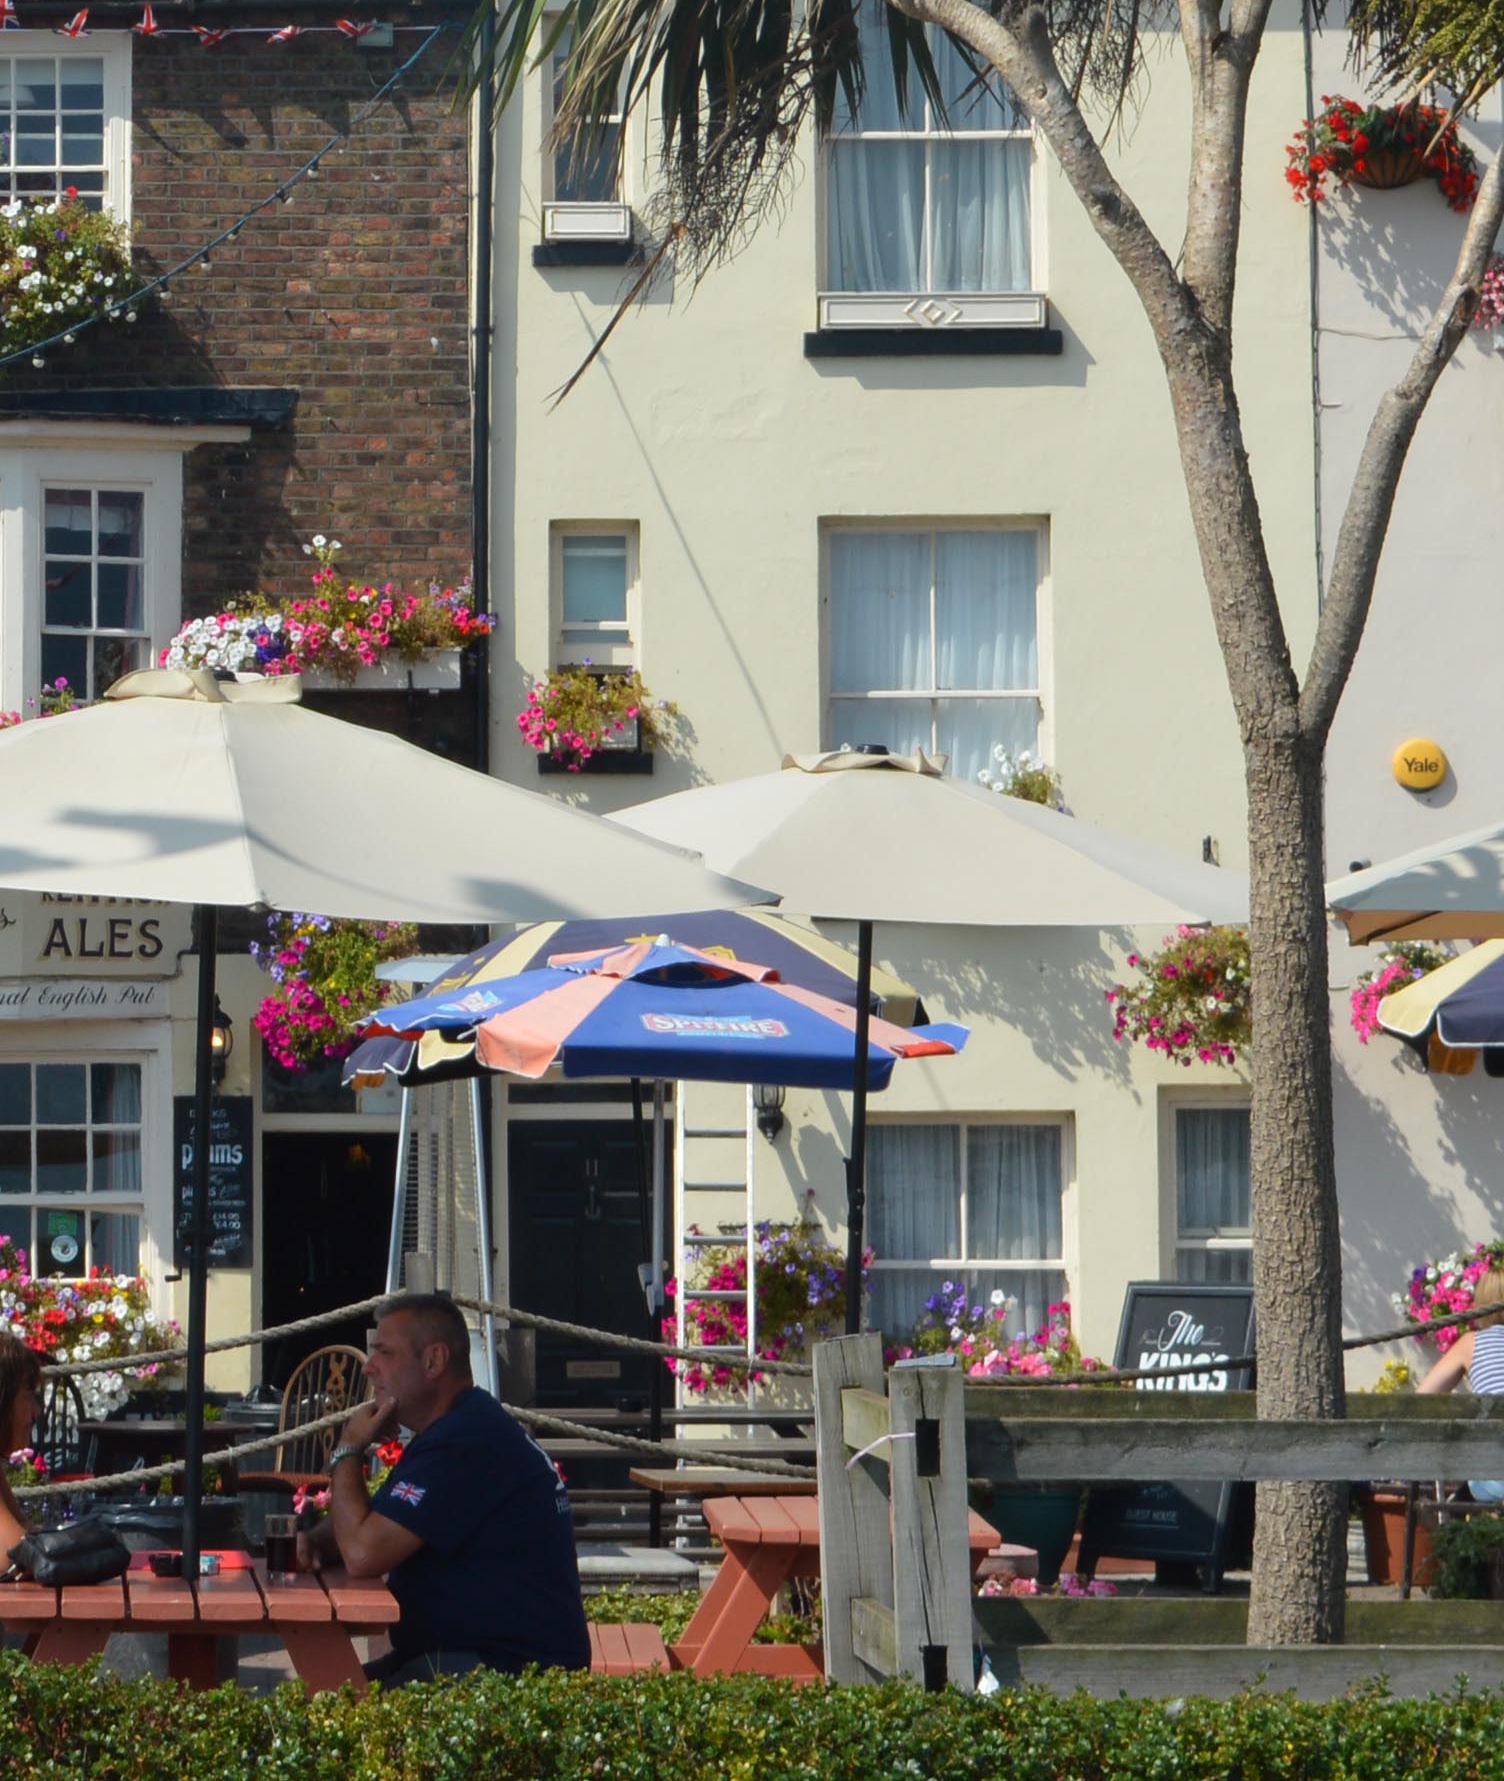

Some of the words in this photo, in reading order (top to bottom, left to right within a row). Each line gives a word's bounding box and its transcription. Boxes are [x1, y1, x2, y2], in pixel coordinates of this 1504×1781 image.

[1403, 756, 1440, 773] Yale
[41, 917, 164, 959] ALES
[38, 985, 107, 1012] English
[115, 986, 155, 1006] Pub
[654, 1016, 777, 1035] SPITFIRE
[1157, 1310, 1205, 1352] The
